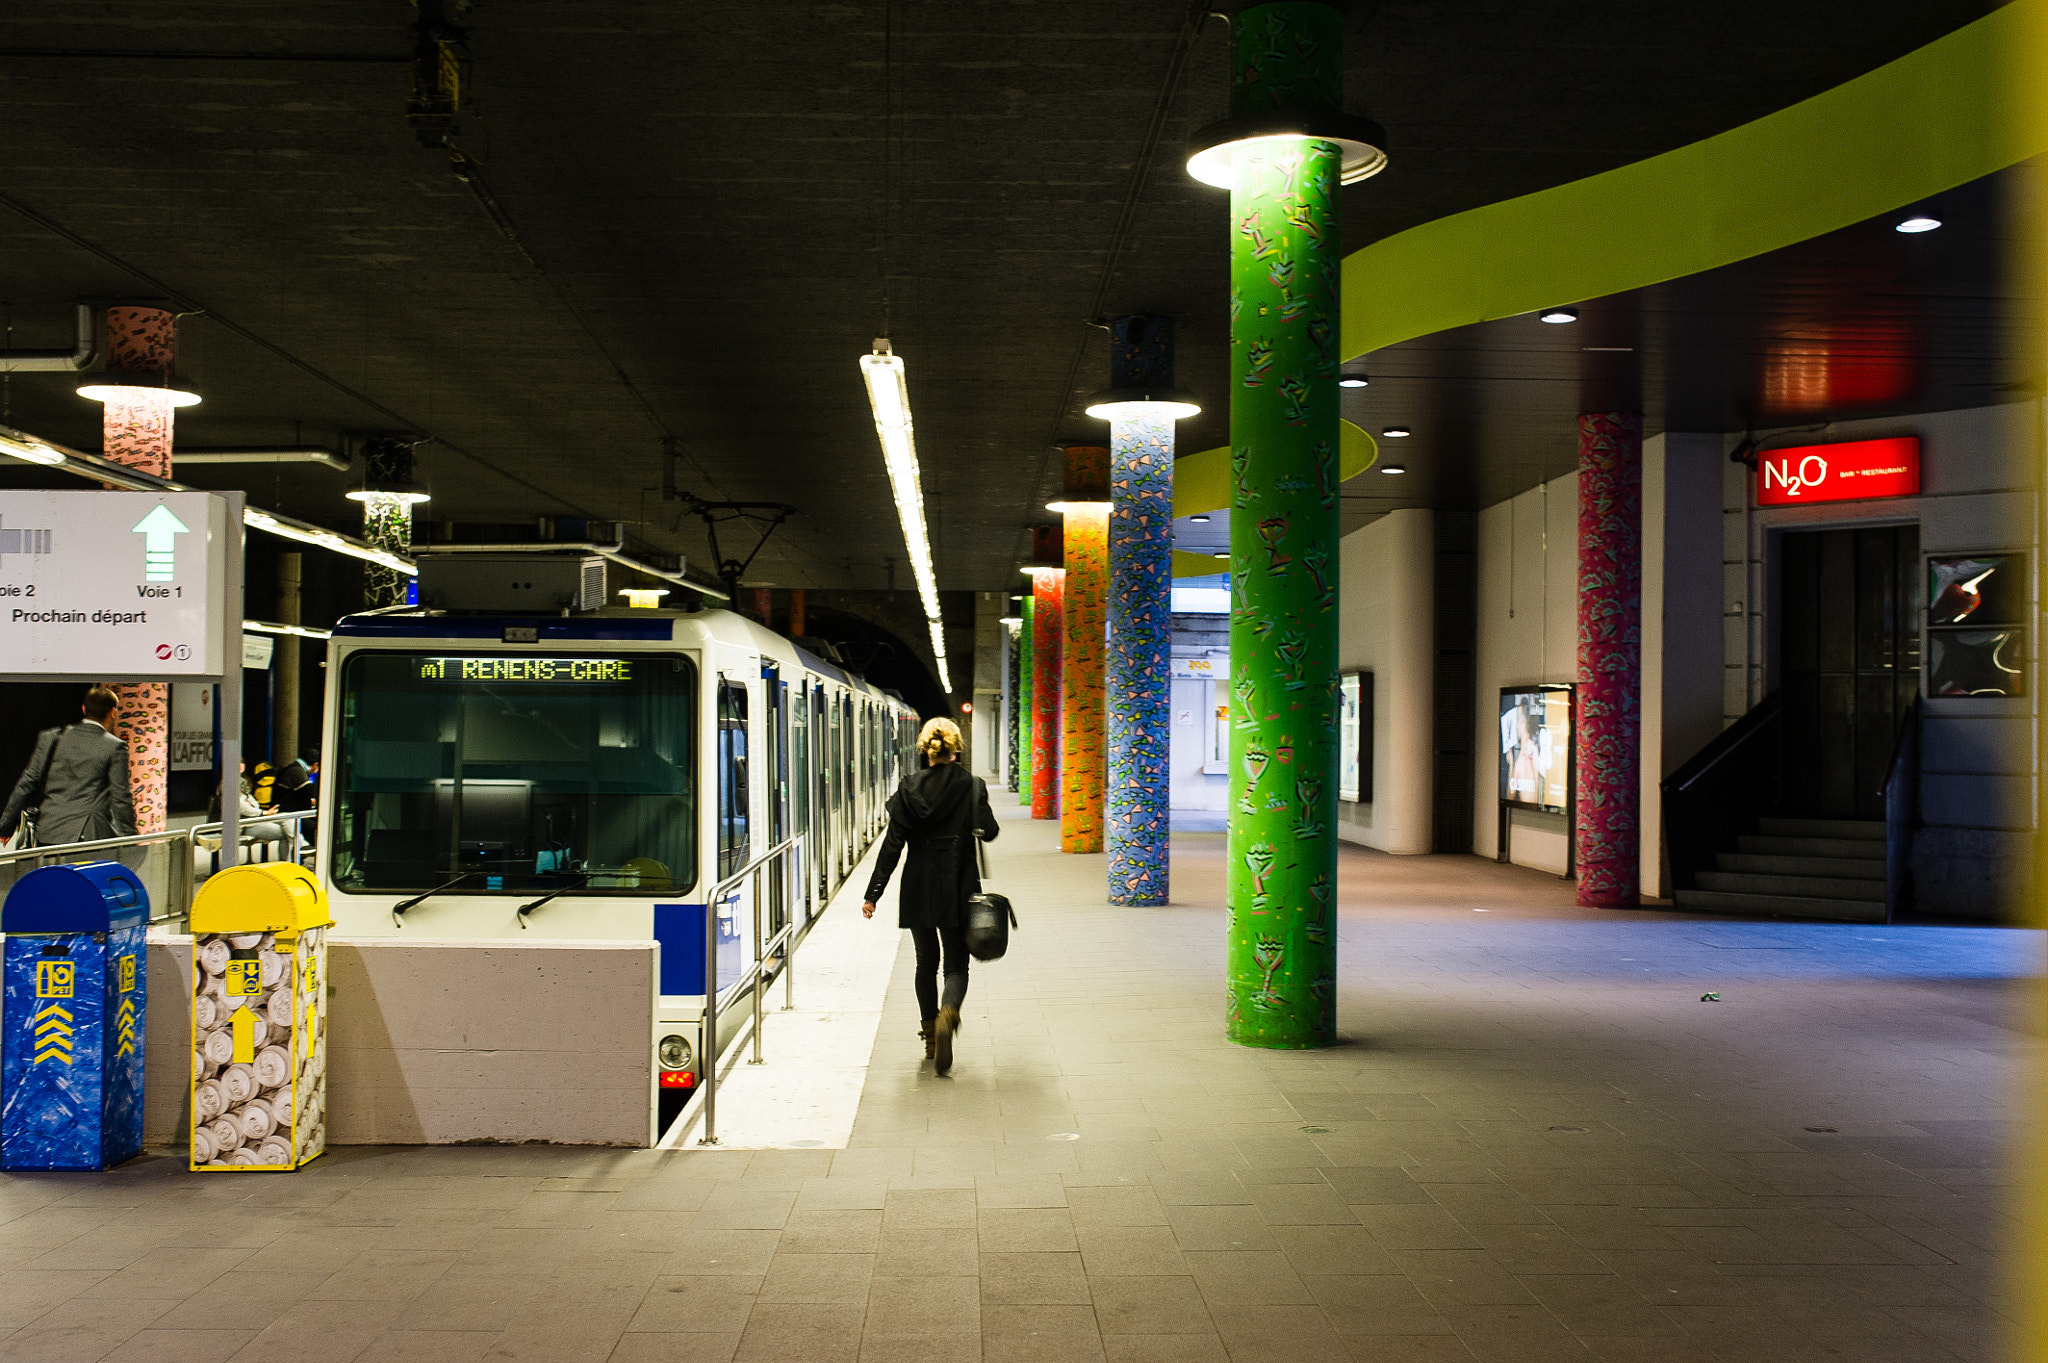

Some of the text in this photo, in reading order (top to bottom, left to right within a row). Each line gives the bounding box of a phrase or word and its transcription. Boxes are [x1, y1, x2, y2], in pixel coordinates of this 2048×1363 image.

[25, 584, 36, 597] 2
[137, 585, 182, 598] Voie 1
[12, 608, 147, 626] Prochain départ
[462, 660, 633, 680] RENENS-GARE
[53, 986, 70, 994] PET
